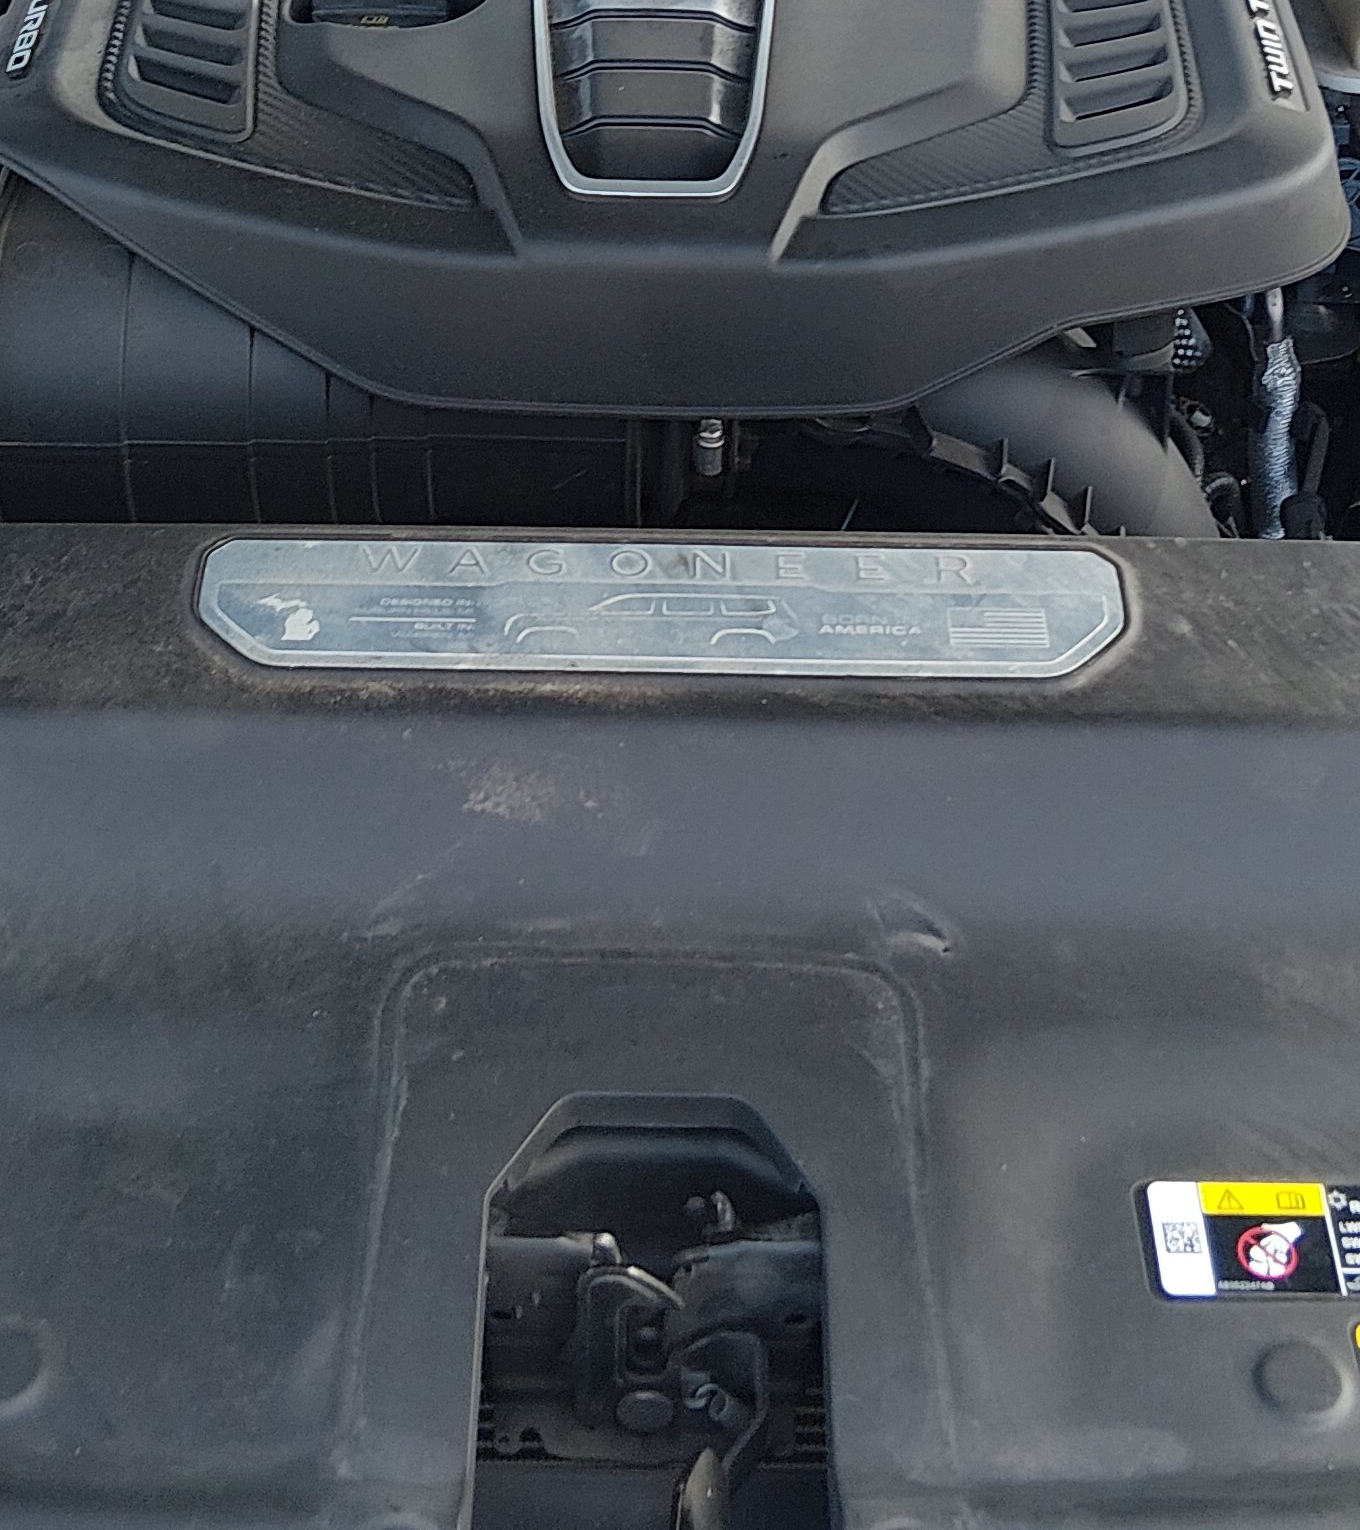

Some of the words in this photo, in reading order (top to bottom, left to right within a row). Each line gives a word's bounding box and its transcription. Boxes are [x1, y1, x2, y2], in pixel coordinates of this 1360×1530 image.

[1255, 18, 1294, 94] TWIN
[360, 545, 977, 584] WAGONEER
[818, 624, 922, 636] AMERICA
